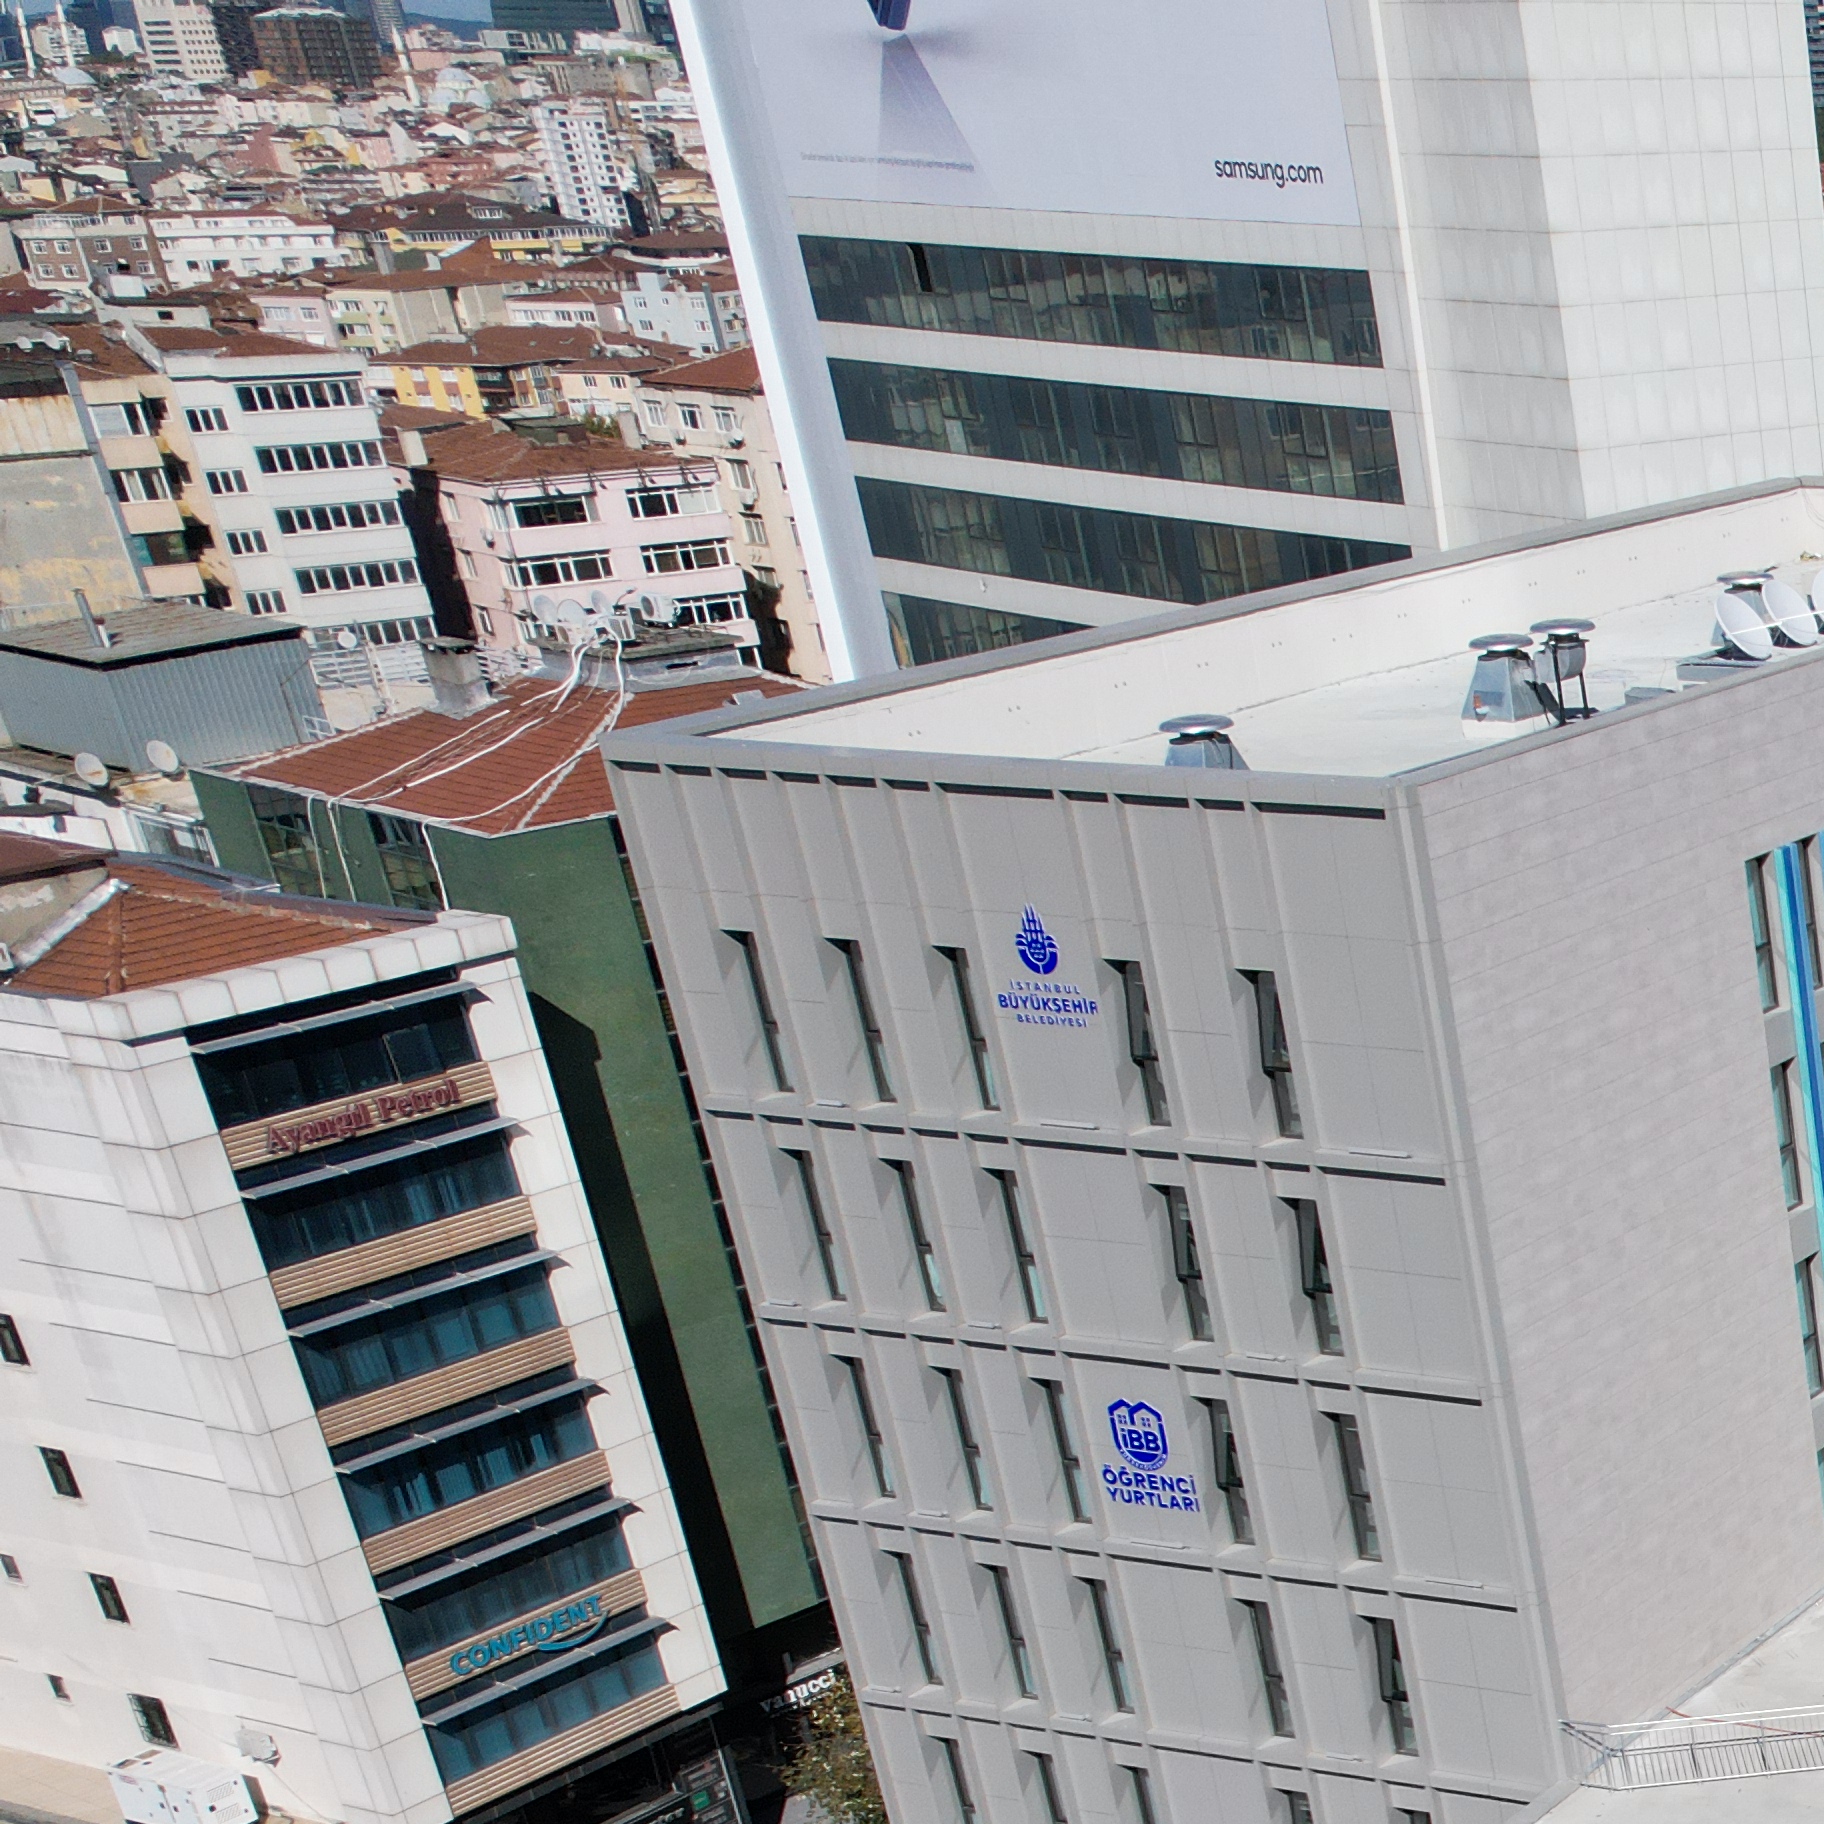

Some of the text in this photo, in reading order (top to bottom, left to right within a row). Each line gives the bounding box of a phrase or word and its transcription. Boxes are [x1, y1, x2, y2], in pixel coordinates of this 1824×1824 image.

[1214, 159, 1324, 188] samsung.com
[1009, 978, 1081, 995] İSTANBUL
[997, 991, 1099, 1015] BÜYÜKŞEHİR
[1016, 1013, 1088, 1028] BELEDİYESİ
[375, 1079, 461, 1122] Petrol
[1102, 1463, 1196, 1495] ÖĞRENCİ
[1105, 1485, 1201, 1513] YURTLARI
[450, 1594, 602, 1676] CONFIDENT
